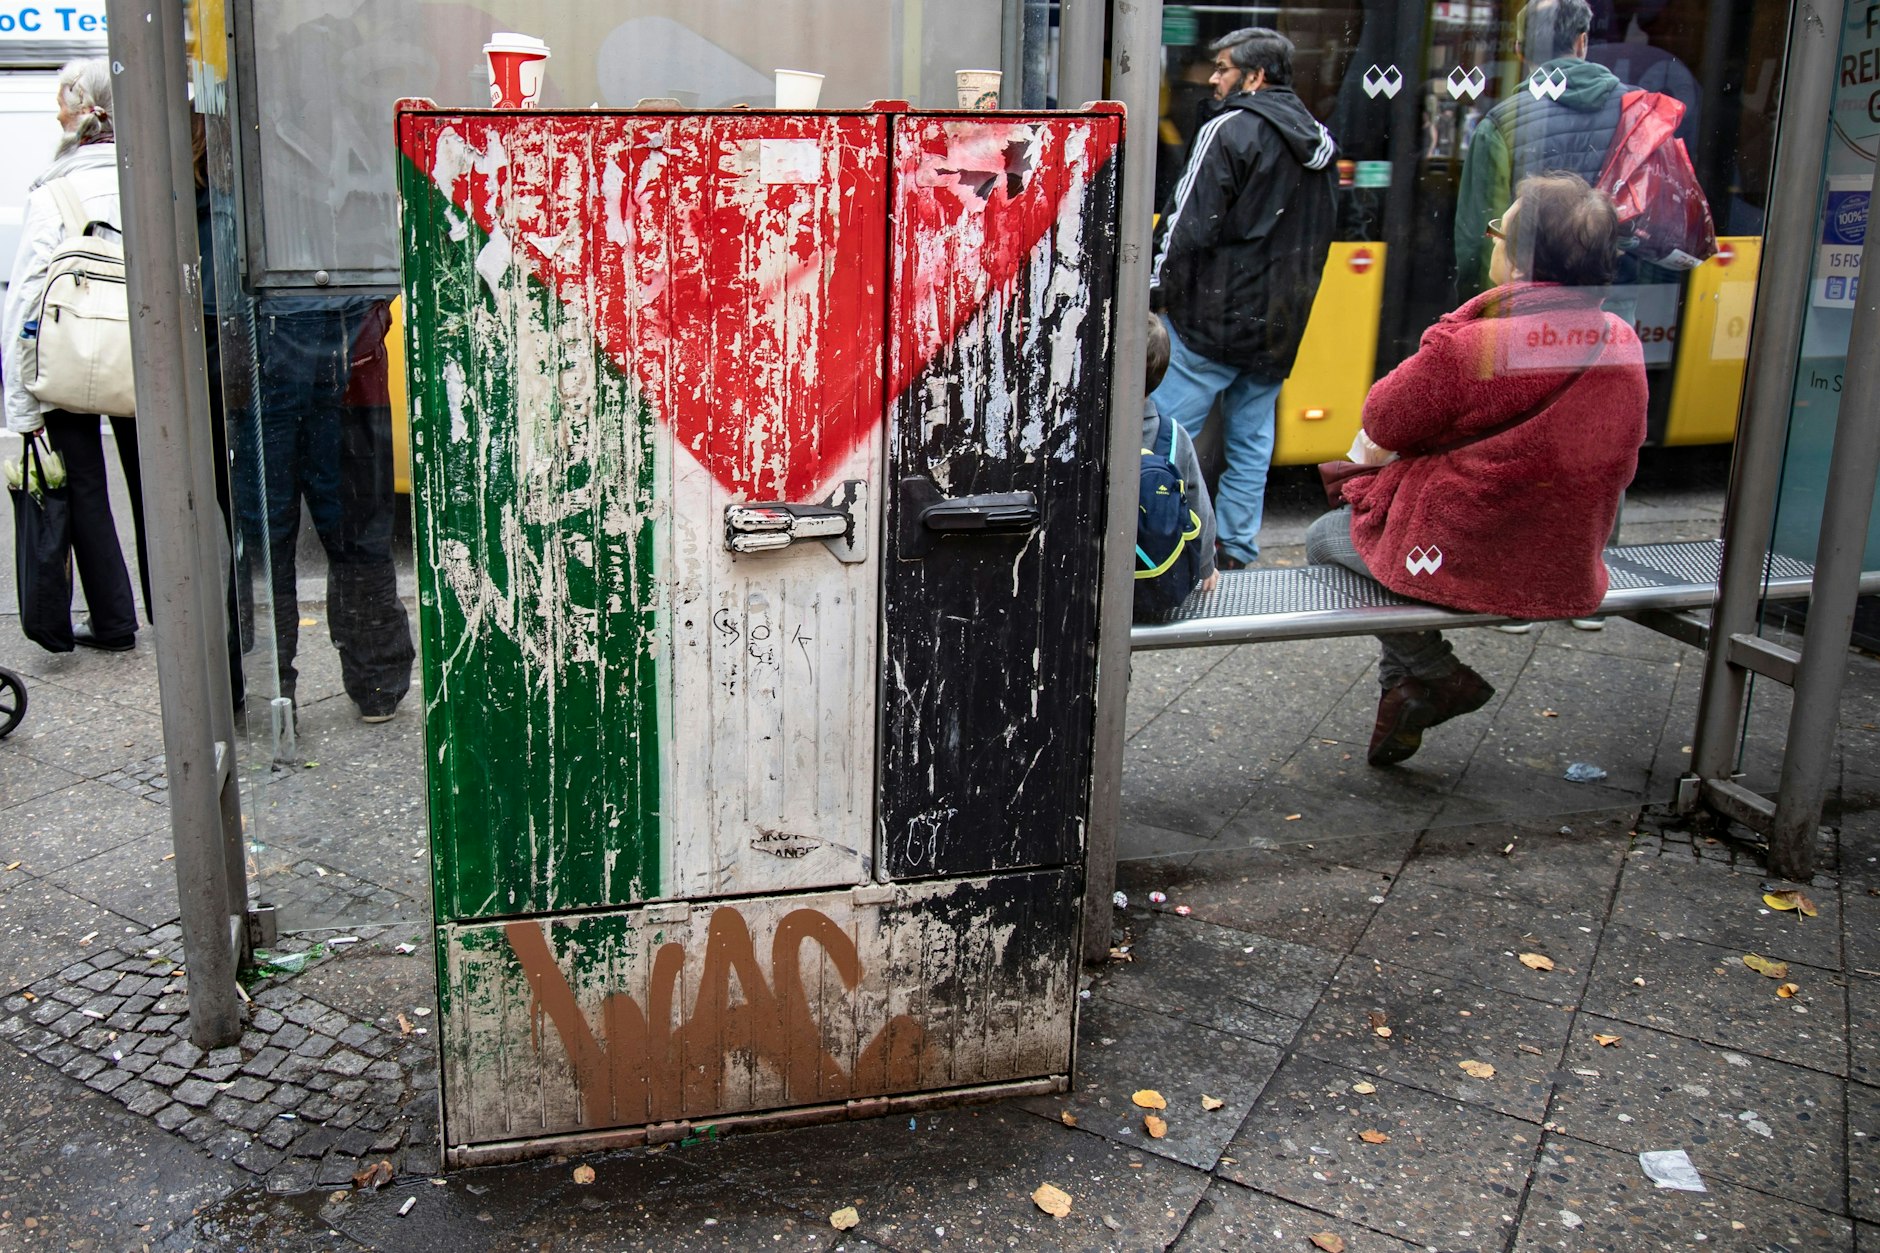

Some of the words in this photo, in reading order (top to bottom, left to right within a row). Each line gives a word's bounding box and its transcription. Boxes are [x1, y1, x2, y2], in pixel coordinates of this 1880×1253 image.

[1839, 211, 1862, 225] 100%
[1830, 253, 1841, 267] 15
[1843, 253, 1861, 268] FIS
[1810, 370, 1828, 390] Im
